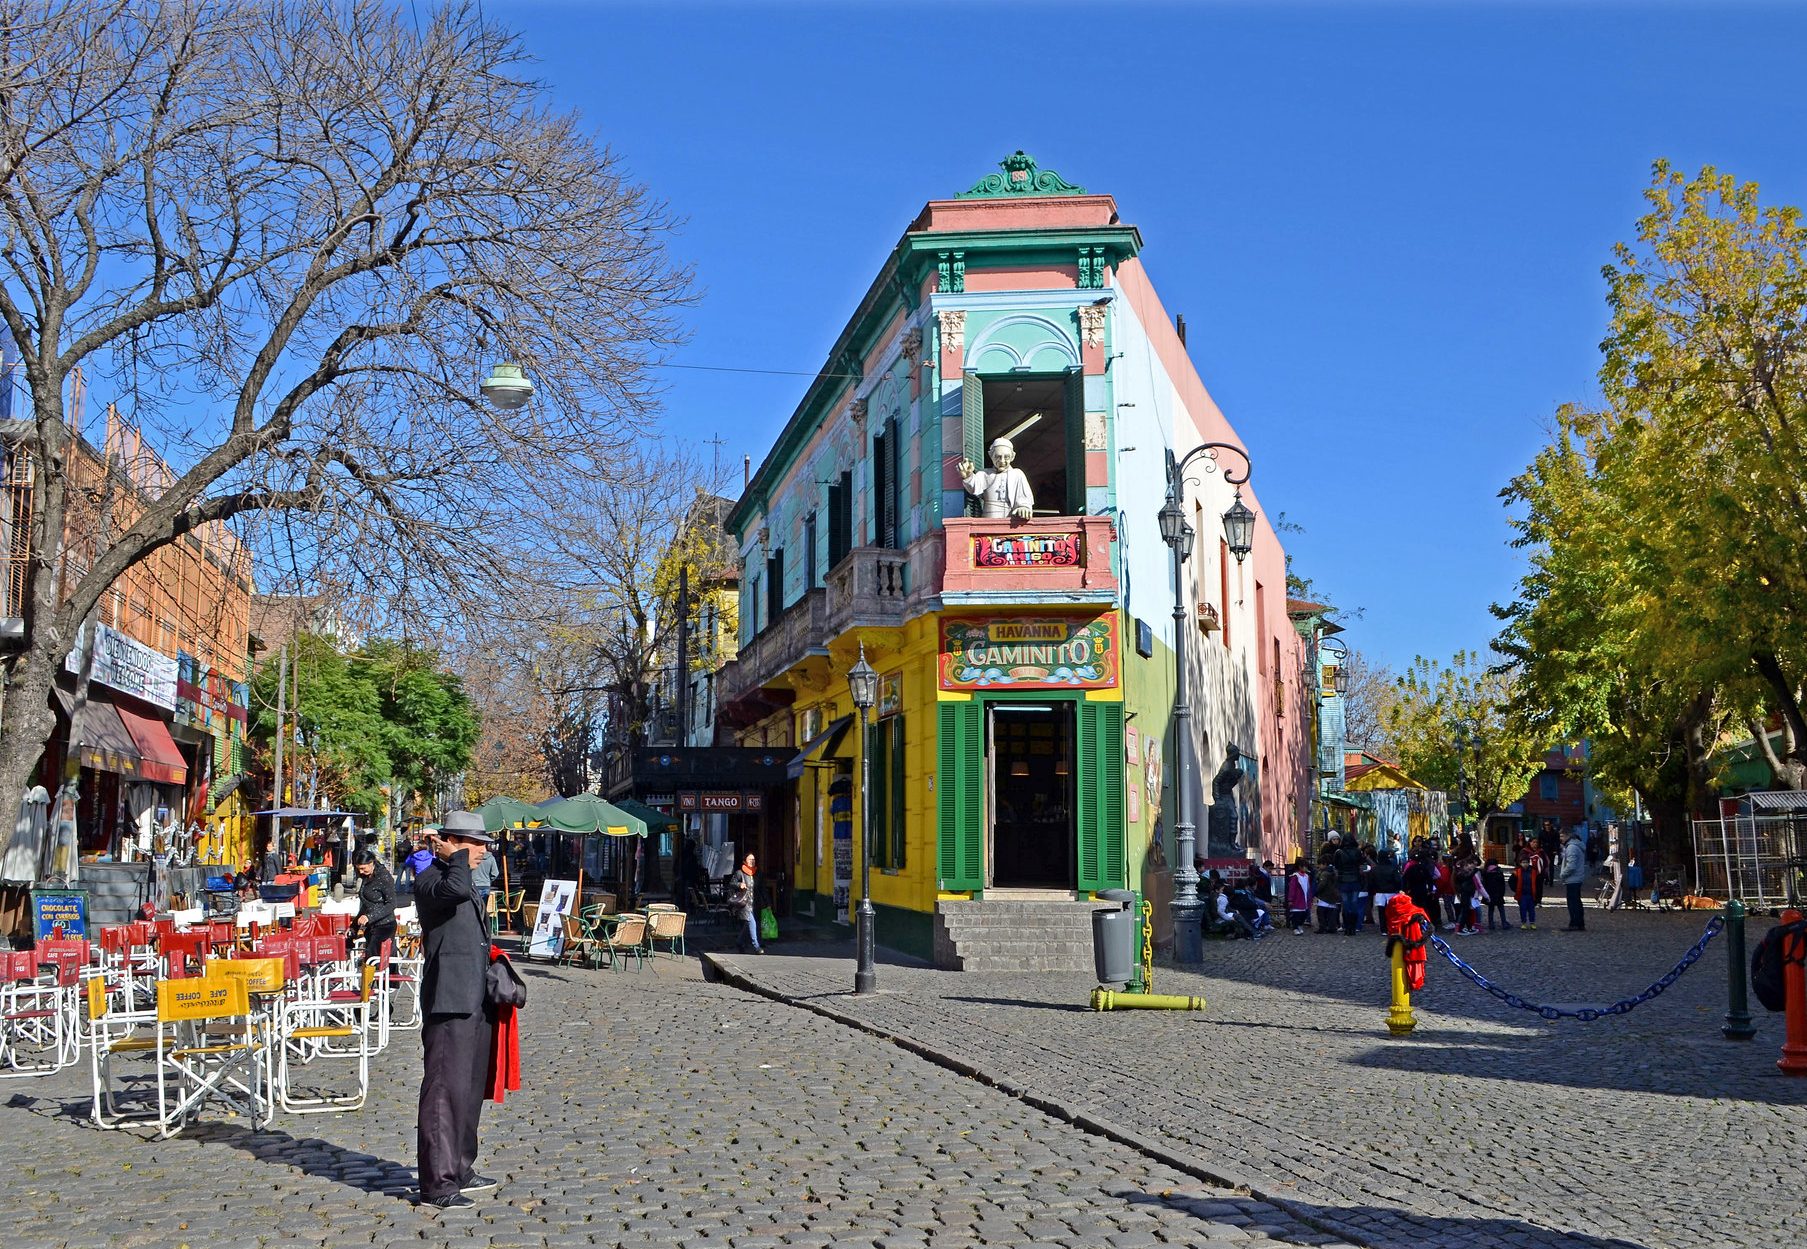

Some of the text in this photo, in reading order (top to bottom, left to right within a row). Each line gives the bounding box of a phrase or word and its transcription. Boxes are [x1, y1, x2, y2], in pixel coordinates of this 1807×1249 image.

[1006, 552, 1053, 561] AMIGO
[996, 626, 1061, 638] HAVANNA
[105, 635, 151, 672] BIENVENIDOS
[968, 639, 1090, 666] CAMINITO
[110, 661, 145, 692] WELCOME
[704, 797, 738, 807] TANGO
[176, 989, 227, 1001] CAFE COFFEE
